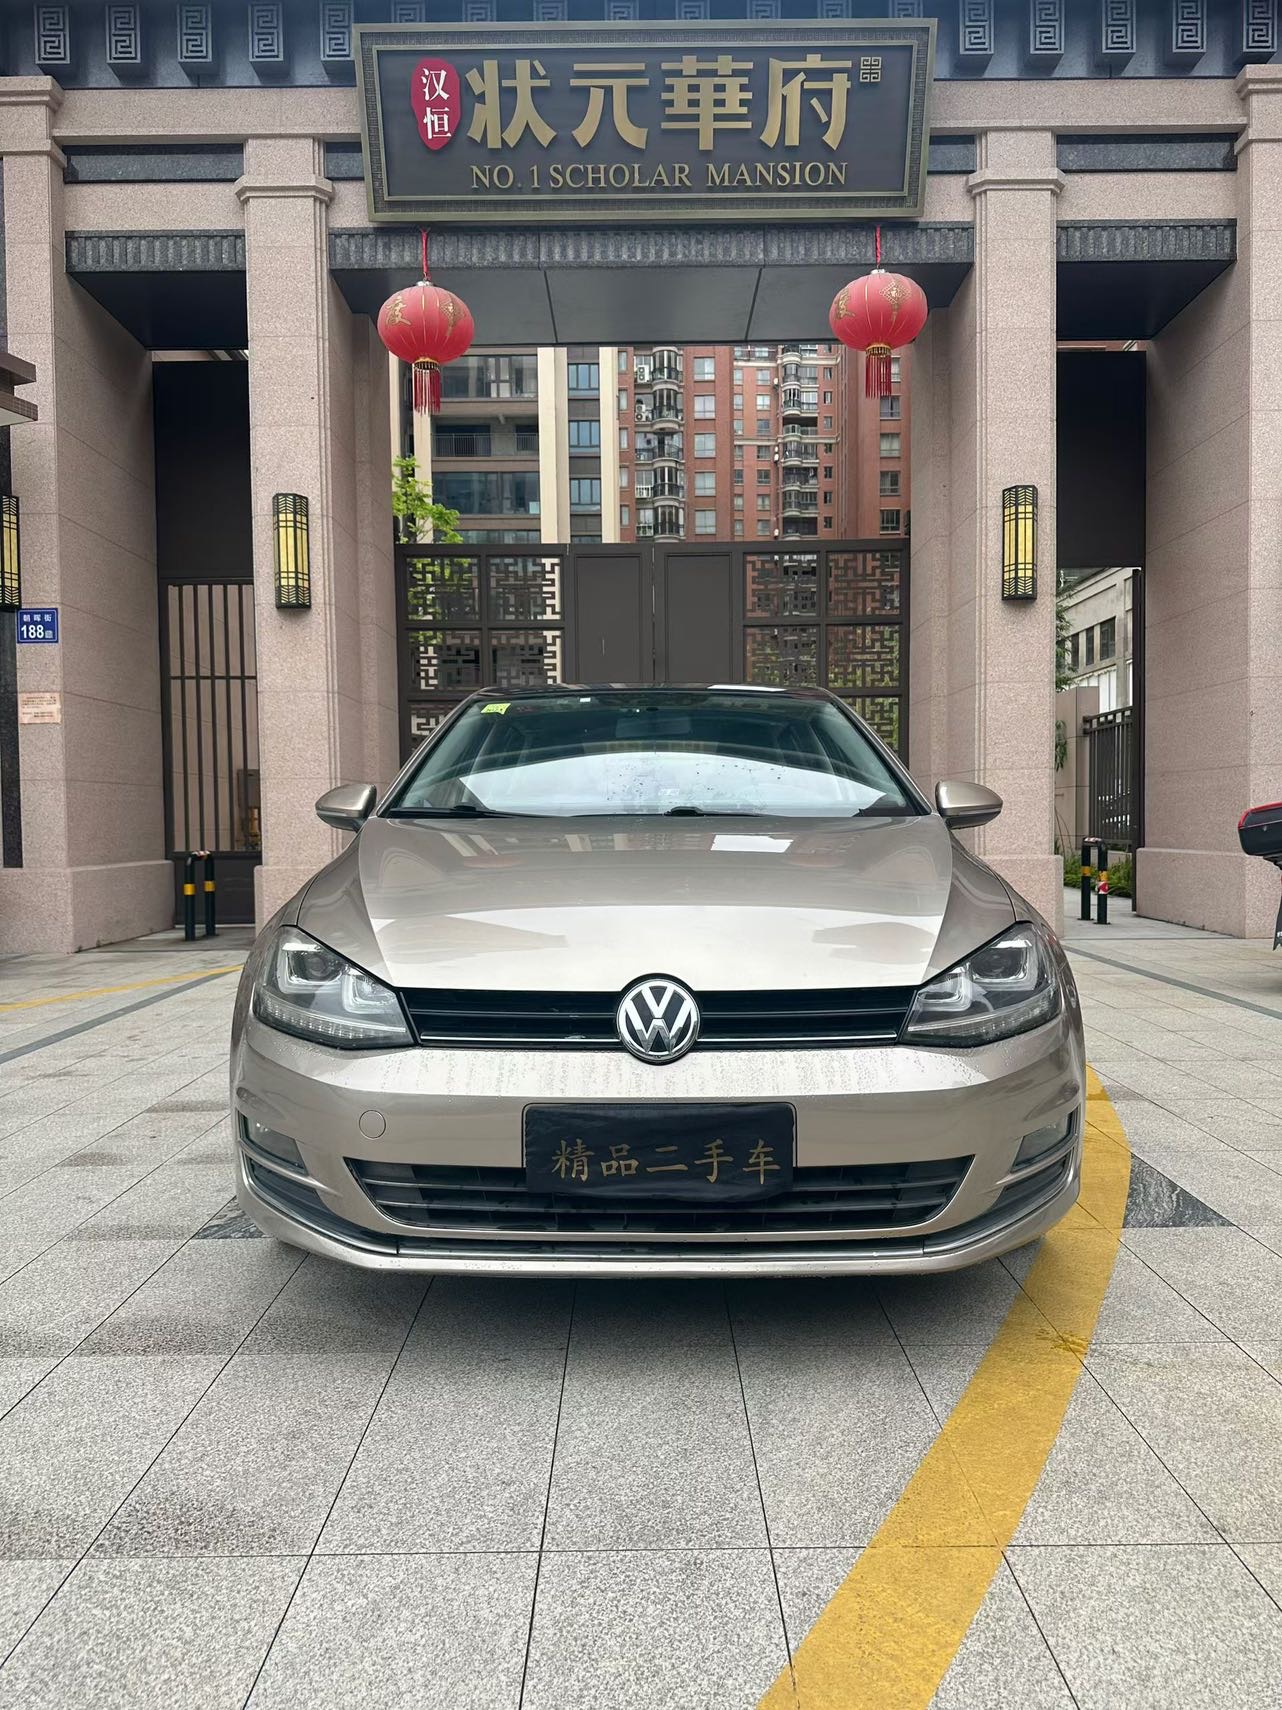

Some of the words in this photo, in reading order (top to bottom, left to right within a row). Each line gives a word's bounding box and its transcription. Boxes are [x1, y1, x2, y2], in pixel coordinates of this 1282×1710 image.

[421, 68, 452, 140] 汉恒
[465, 53, 852, 151] 状元華府
[549, 163, 693, 188] SCHOLAR
[706, 161, 848, 187] MANSION
[551, 1138, 781, 1185] 精品二手车
